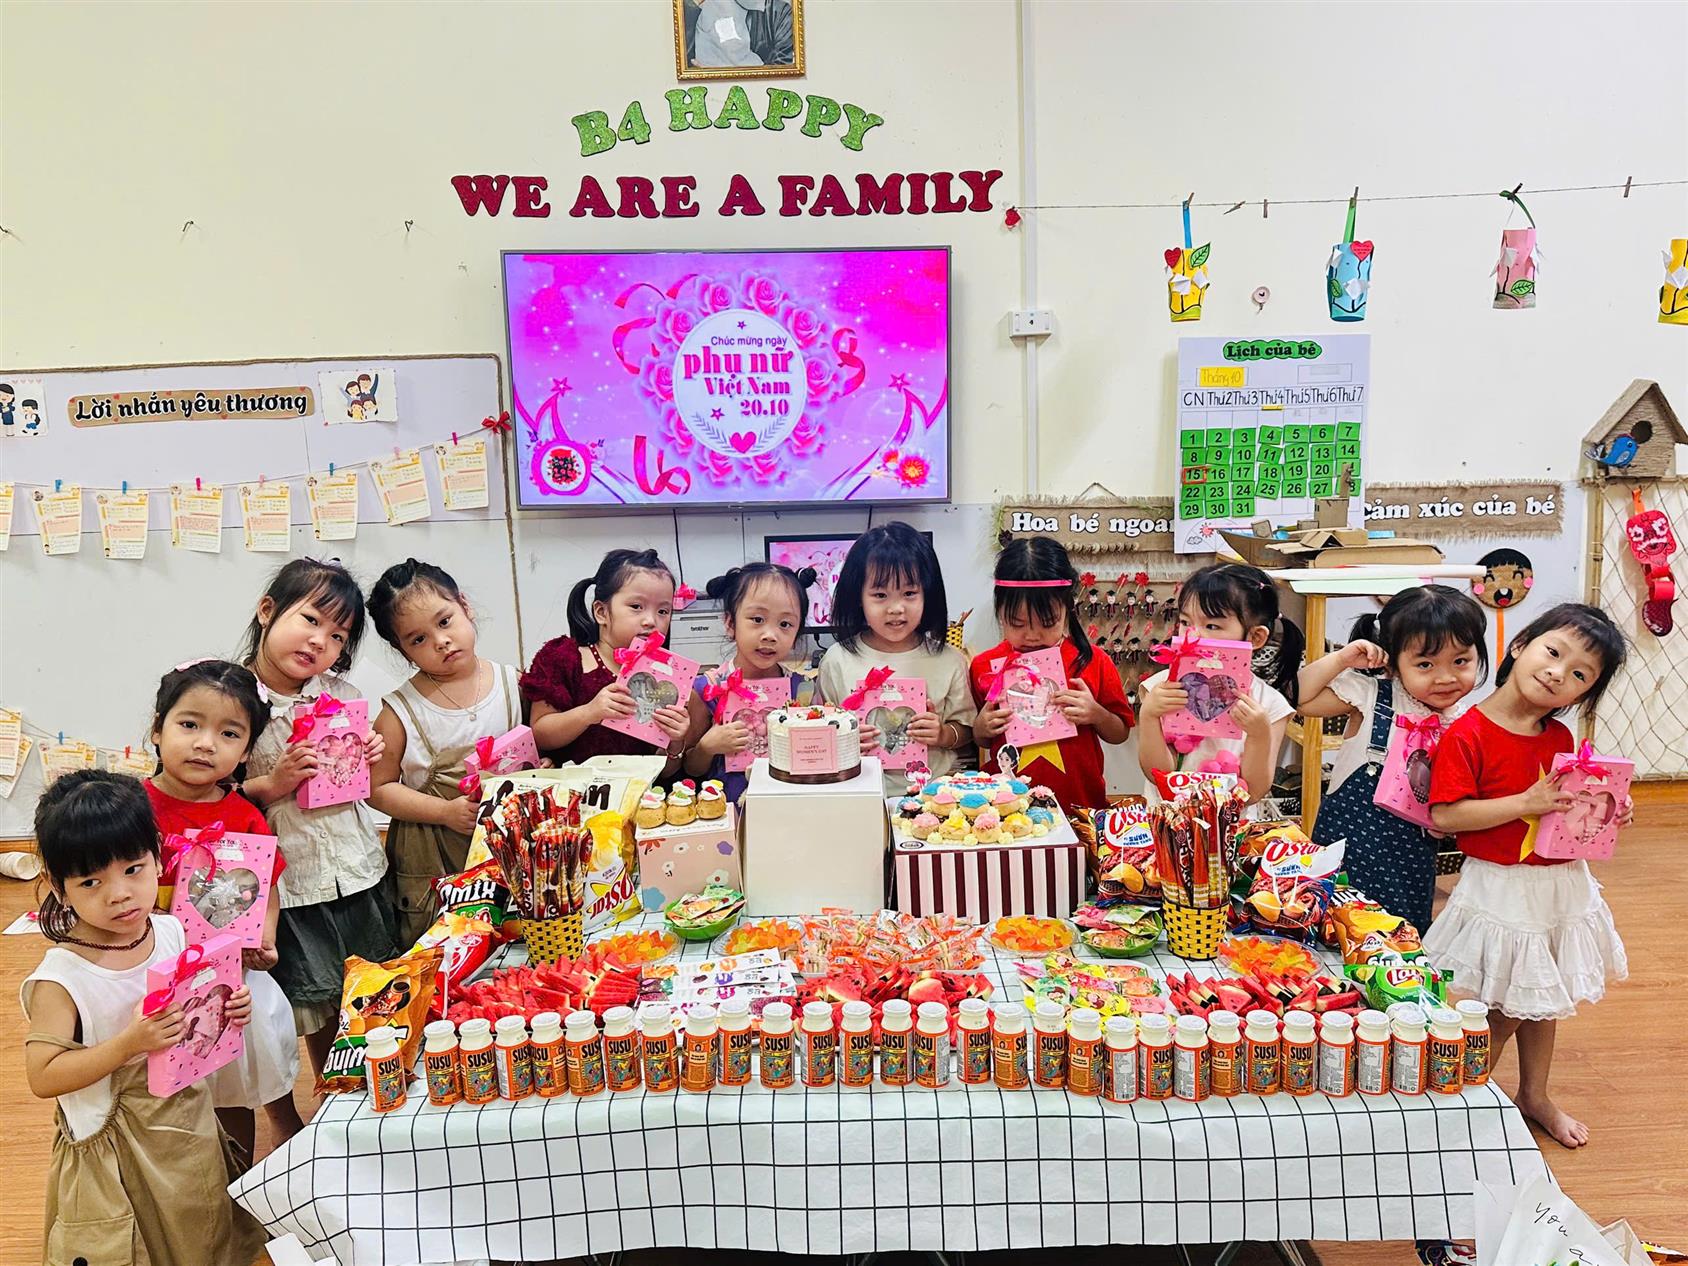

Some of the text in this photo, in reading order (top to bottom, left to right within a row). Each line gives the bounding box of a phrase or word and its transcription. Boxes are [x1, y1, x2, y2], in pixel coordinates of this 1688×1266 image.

[571, 85, 885, 156] B4 HAPPY
[451, 170, 1003, 218] WE ARE A FAMILY
[711, 335, 788, 348] Chúc mừng ngày
[1226, 342, 1316, 361] Lịch của bé
[683, 346, 794, 379] phụ nữ
[705, 376, 790, 399] Việt Nam
[76, 392, 307, 421] Lời nhắn yêu thương
[1184, 391, 1205, 406] CN
[740, 399, 789, 416] 20.10
[1189, 426, 1352, 445] 1 2 3 4 5 6 7
[1190, 445, 1355, 463] 8 9 10 11 12 13 14
[1186, 469, 1201, 480] 15
[1211, 469, 1225, 480] 16
[1236, 467, 1250, 478] 17
[1264, 468, 1278, 479] 18
[1289, 466, 1303, 476] 19
[1315, 464, 1330, 475] 20
[1186, 487, 1200, 498] 22
[1210, 487, 1224, 498] 23
[1237, 485, 1251, 496] 24
[1261, 484, 1275, 495] 25
[1287, 483, 1302, 494] 26
[1314, 482, 1329, 494] 27
[1185, 503, 1250, 516] 29 30 31
[1418, 497, 1464, 518] xúc
[1473, 494, 1517, 516] của
[1525, 494, 1556, 515] bé
[1011, 512, 1060, 532] Hoa
[1069, 512, 1099, 533] bé
[608, 1038, 631, 1054] SUSU
[645, 1040, 667, 1054] SUSU
[765, 1037, 790, 1051] SUSU
[812, 1034, 833, 1050] SUSU
[881, 1034, 905, 1048] SUSU
[1041, 1036, 1063, 1051] SUSU
[1432, 1041, 1458, 1058] SUSU
[1466, 1034, 1488, 1049] SUSU
[467, 1049, 493, 1068] SUSU
[512, 1046, 529, 1063] SUS
[581, 1041, 600, 1059] SUS
[1254, 1044, 1277, 1059] SUSU
[1290, 1046, 1312, 1060] SUSU
[378, 1056, 400, 1077] SUSU
[427, 1054, 451, 1070] SUSU
